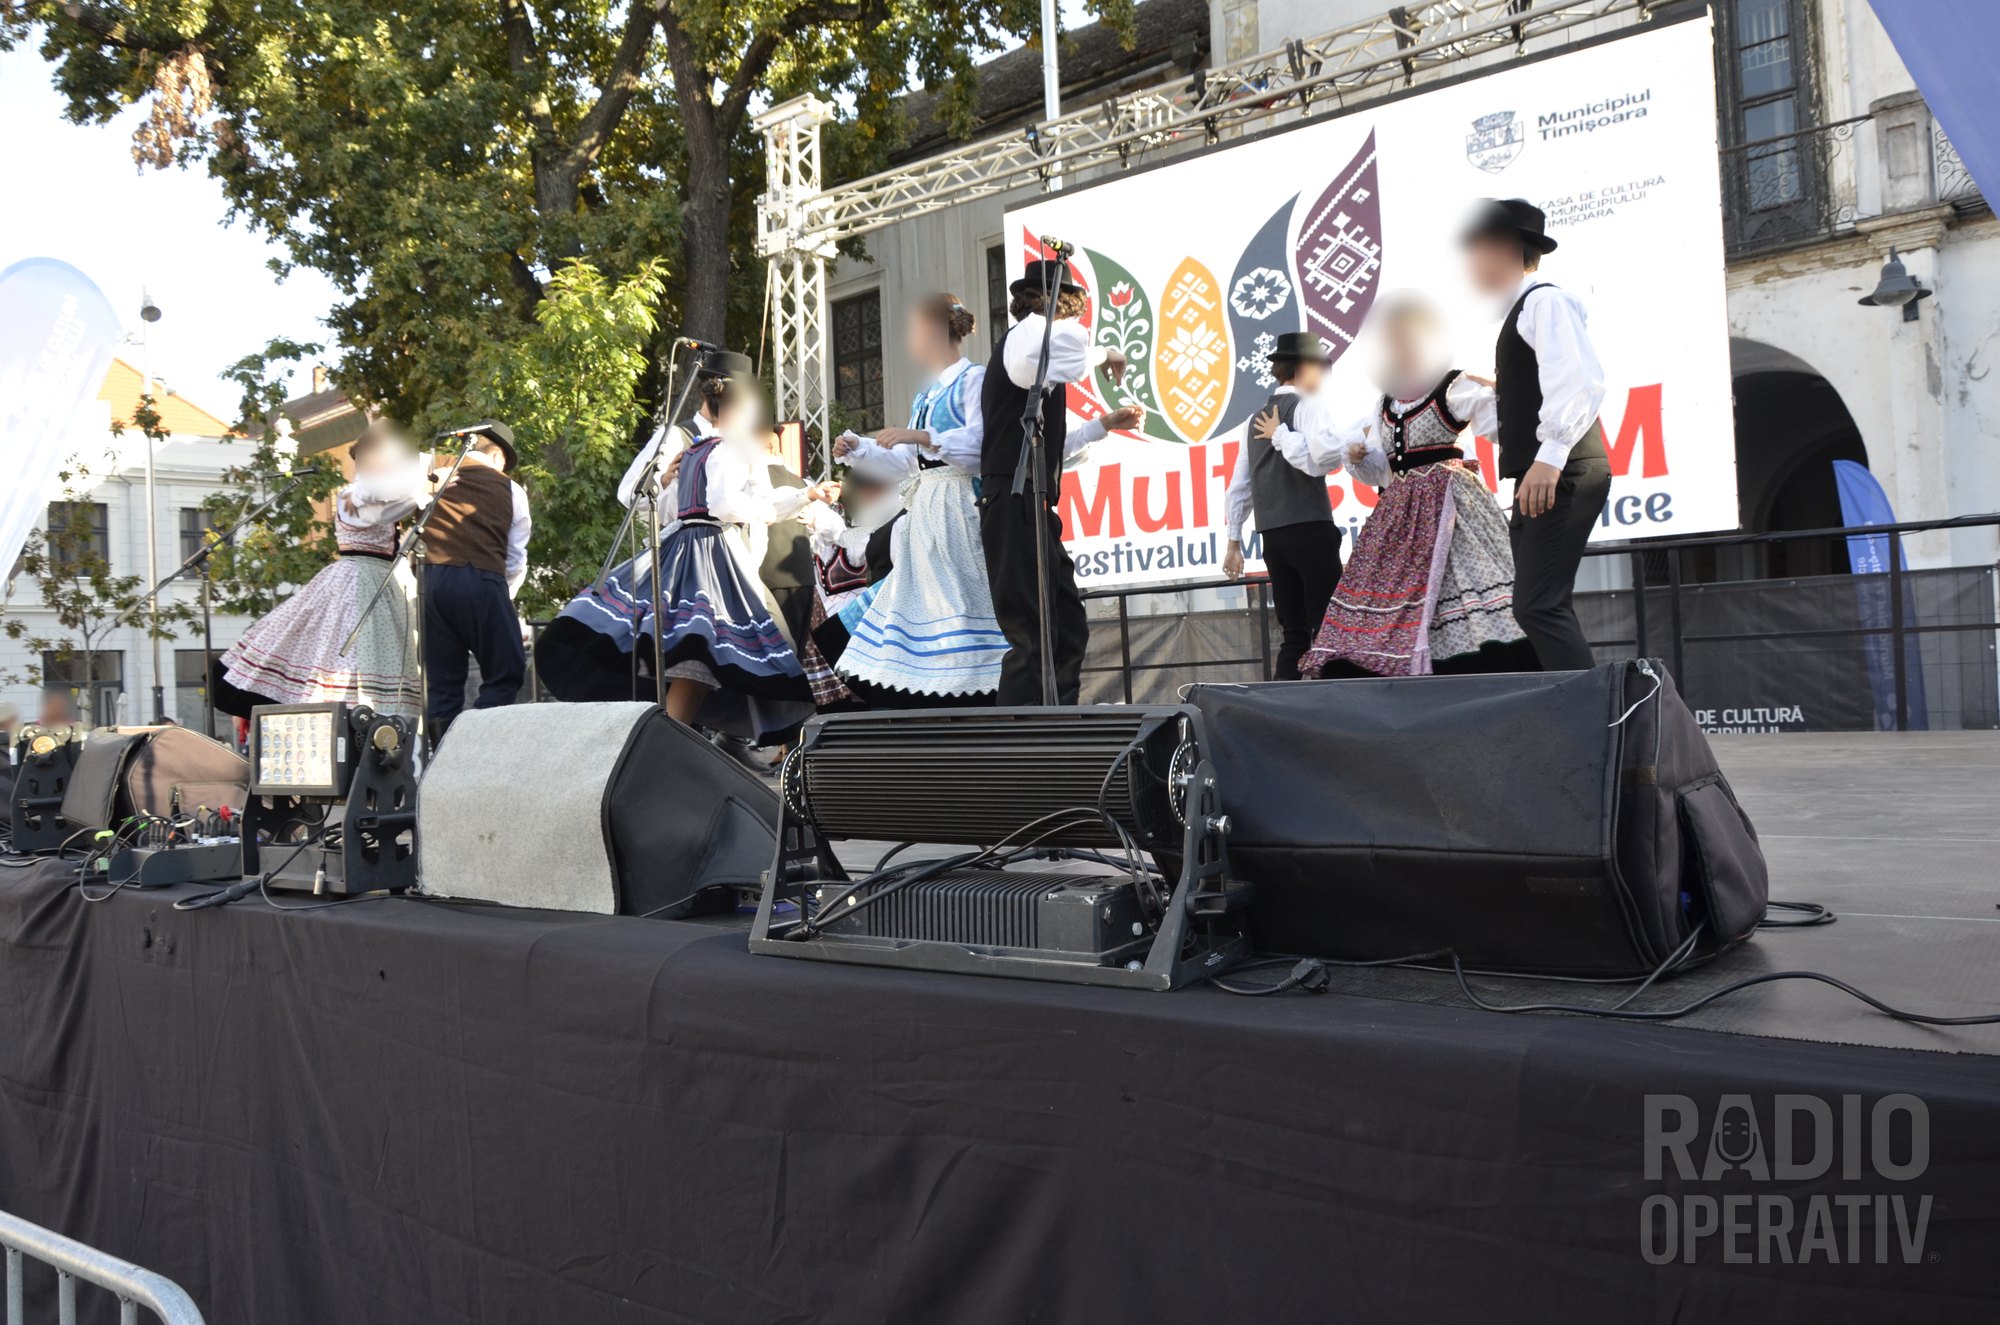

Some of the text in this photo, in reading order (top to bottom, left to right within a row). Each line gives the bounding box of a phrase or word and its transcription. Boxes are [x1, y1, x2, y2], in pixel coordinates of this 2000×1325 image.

[1538, 88, 1651, 127] Municipiul
[1538, 106, 1648, 141] Timișoara
[1539, 196, 1573, 210] CASA
[1580, 191, 1596, 202] DE
[1551, 190, 1647, 218] MUNICIPIULUI
[1066, 532, 1217, 578] estivalul
[1695, 705, 1804, 725] DE CULTURĂ
